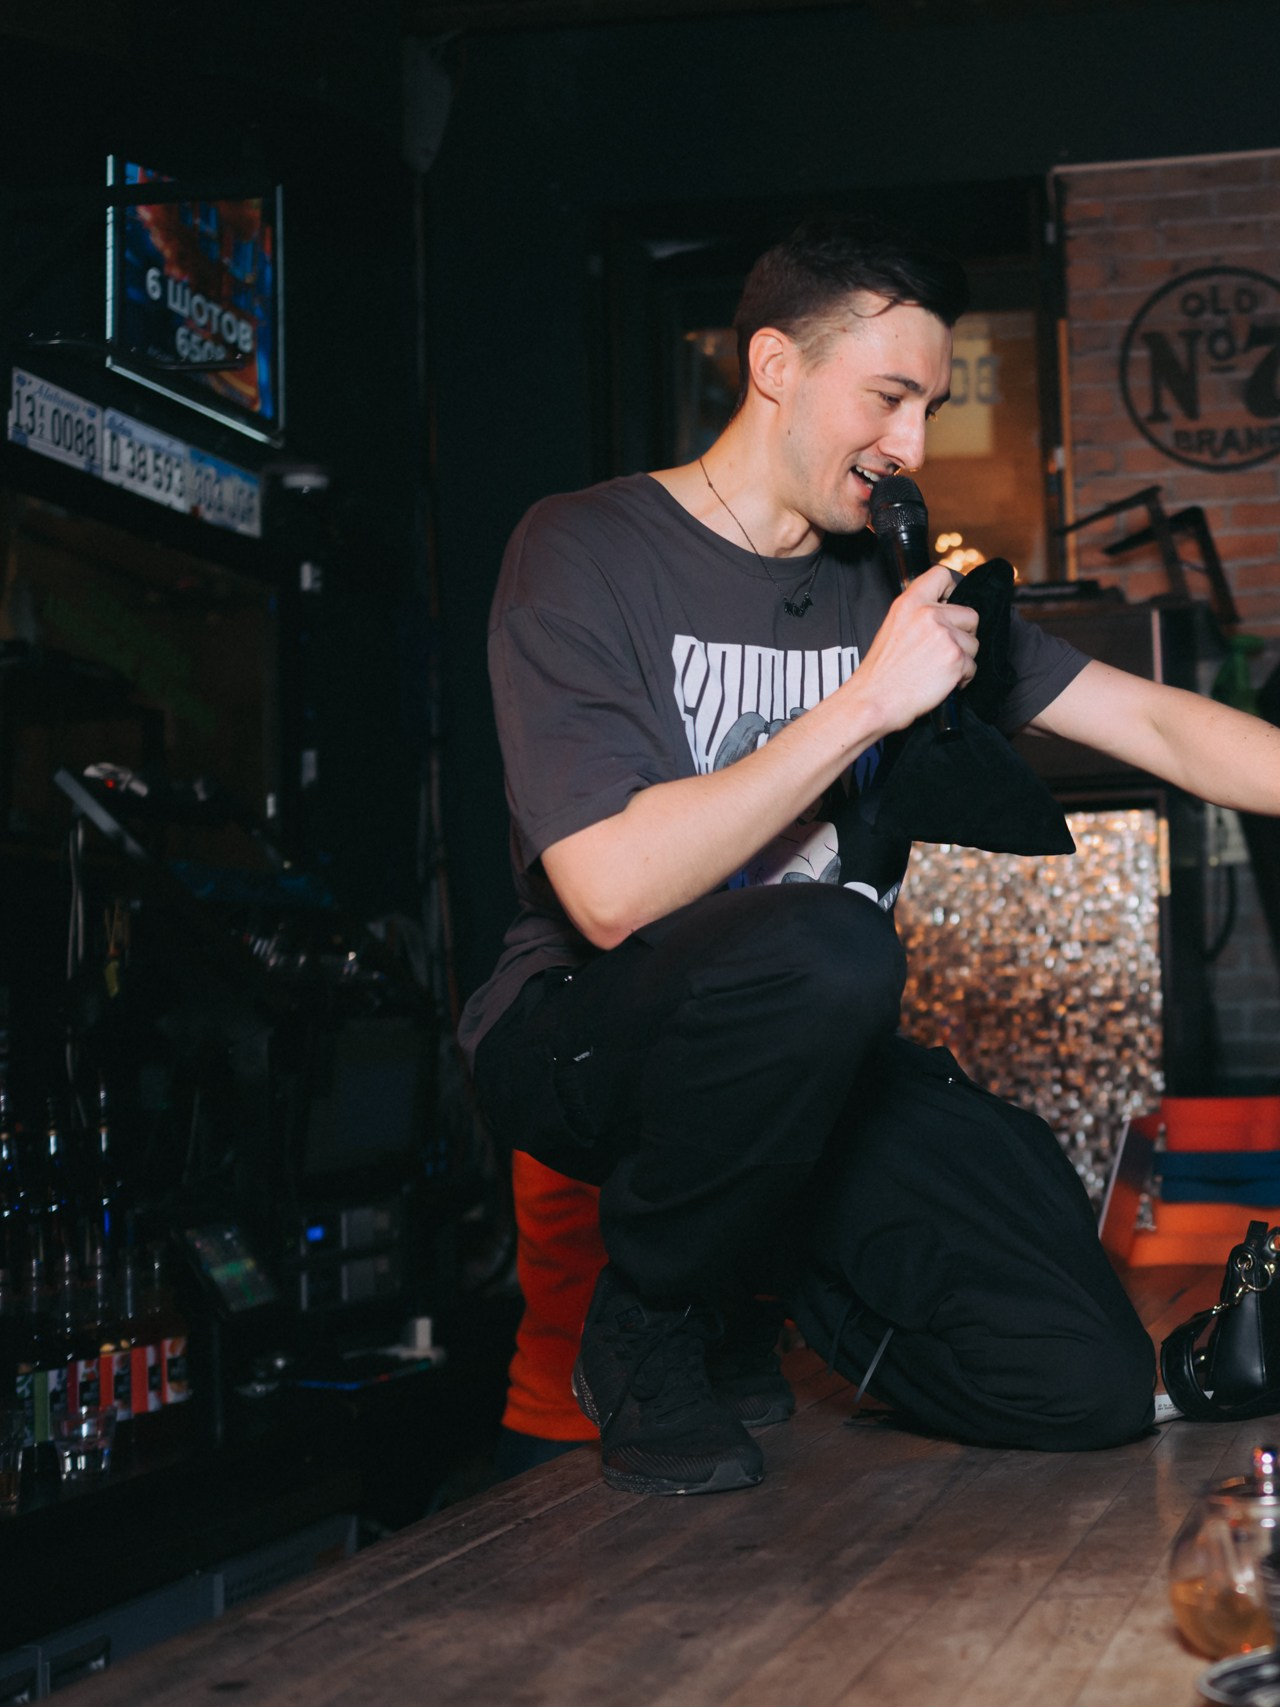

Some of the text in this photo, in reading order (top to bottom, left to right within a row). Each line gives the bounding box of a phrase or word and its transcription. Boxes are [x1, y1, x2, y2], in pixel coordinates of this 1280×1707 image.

[145, 266, 254, 353] 6 ШОТОВ
[1180, 284, 1257, 319] OLD
